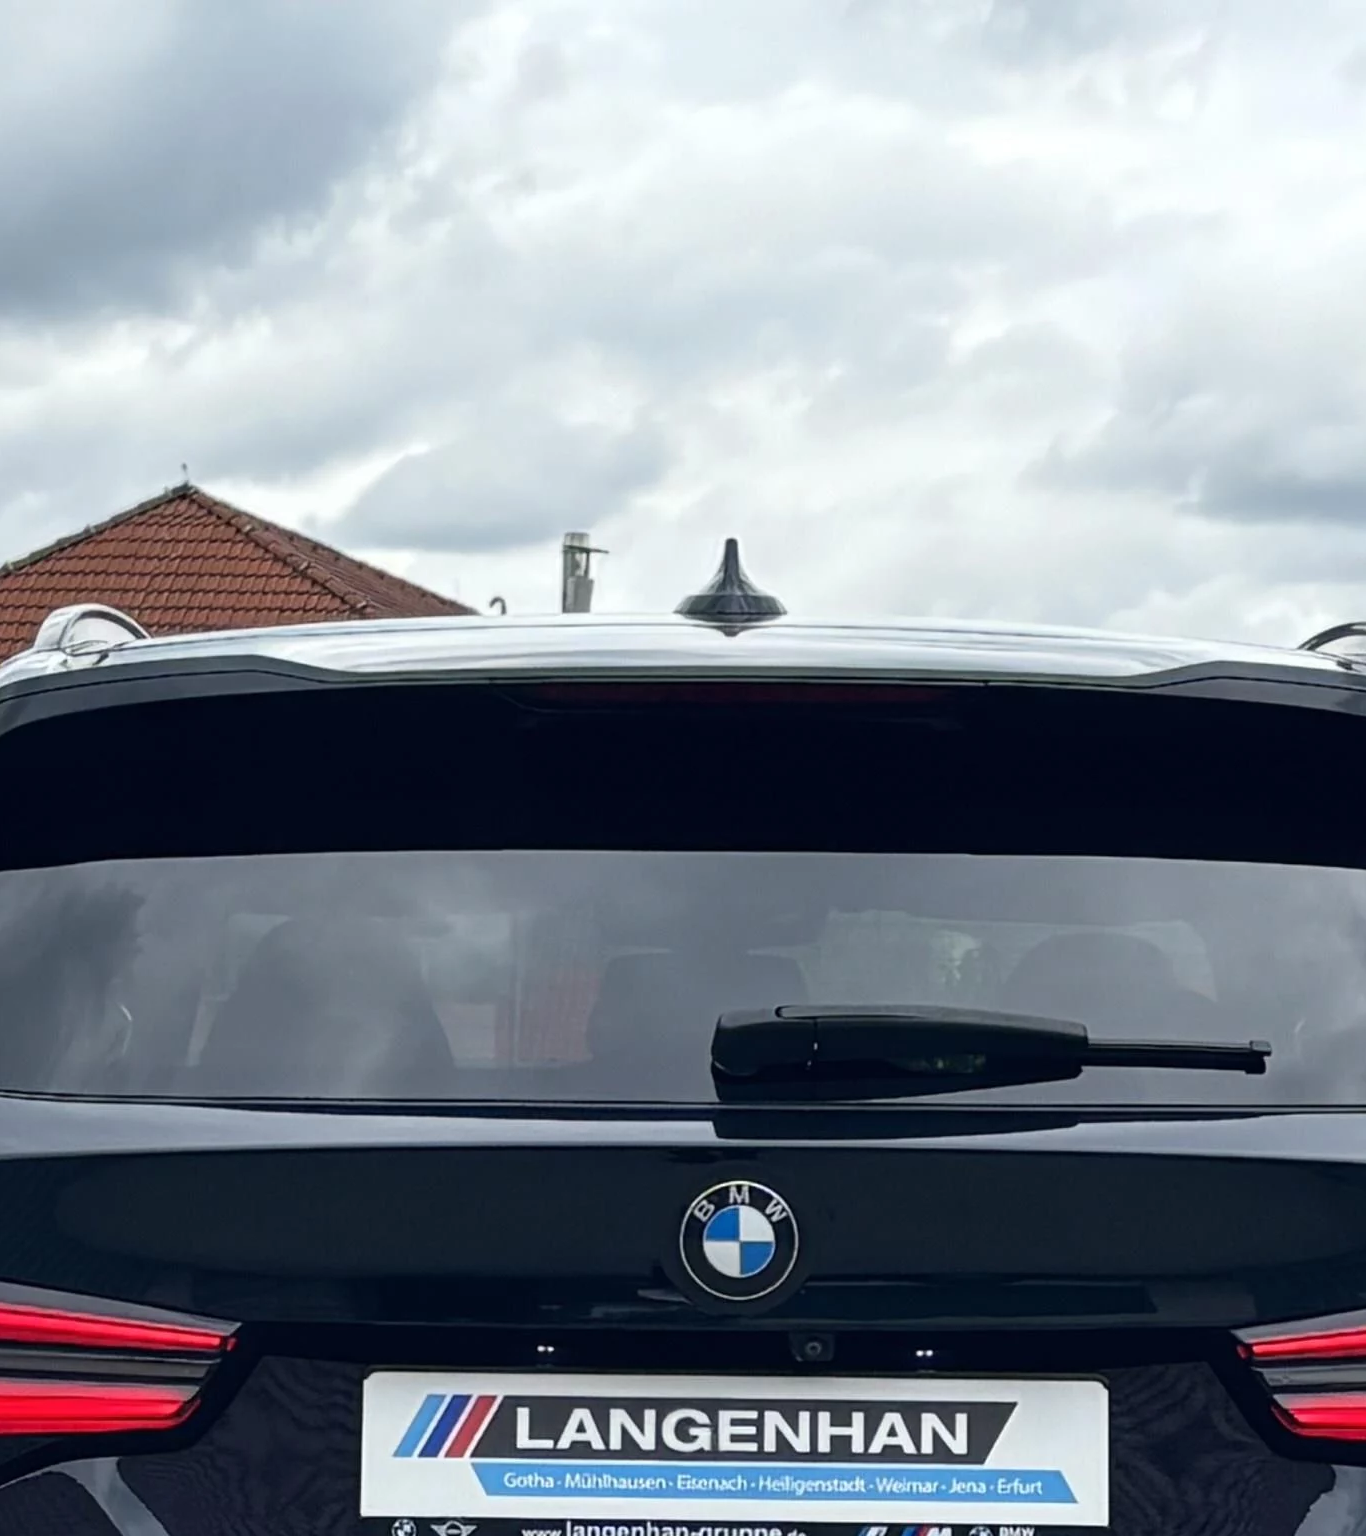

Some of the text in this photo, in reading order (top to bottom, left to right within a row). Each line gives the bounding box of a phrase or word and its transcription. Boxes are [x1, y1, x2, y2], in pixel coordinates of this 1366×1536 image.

[693, 1184, 788, 1222] BMW
[516, 1407, 968, 1454] LANGENHAN
[503, 1472, 1042, 1495] Gotha Mühlhausen Eisenach Heiligenstadt Weimar Jena Erfurt
